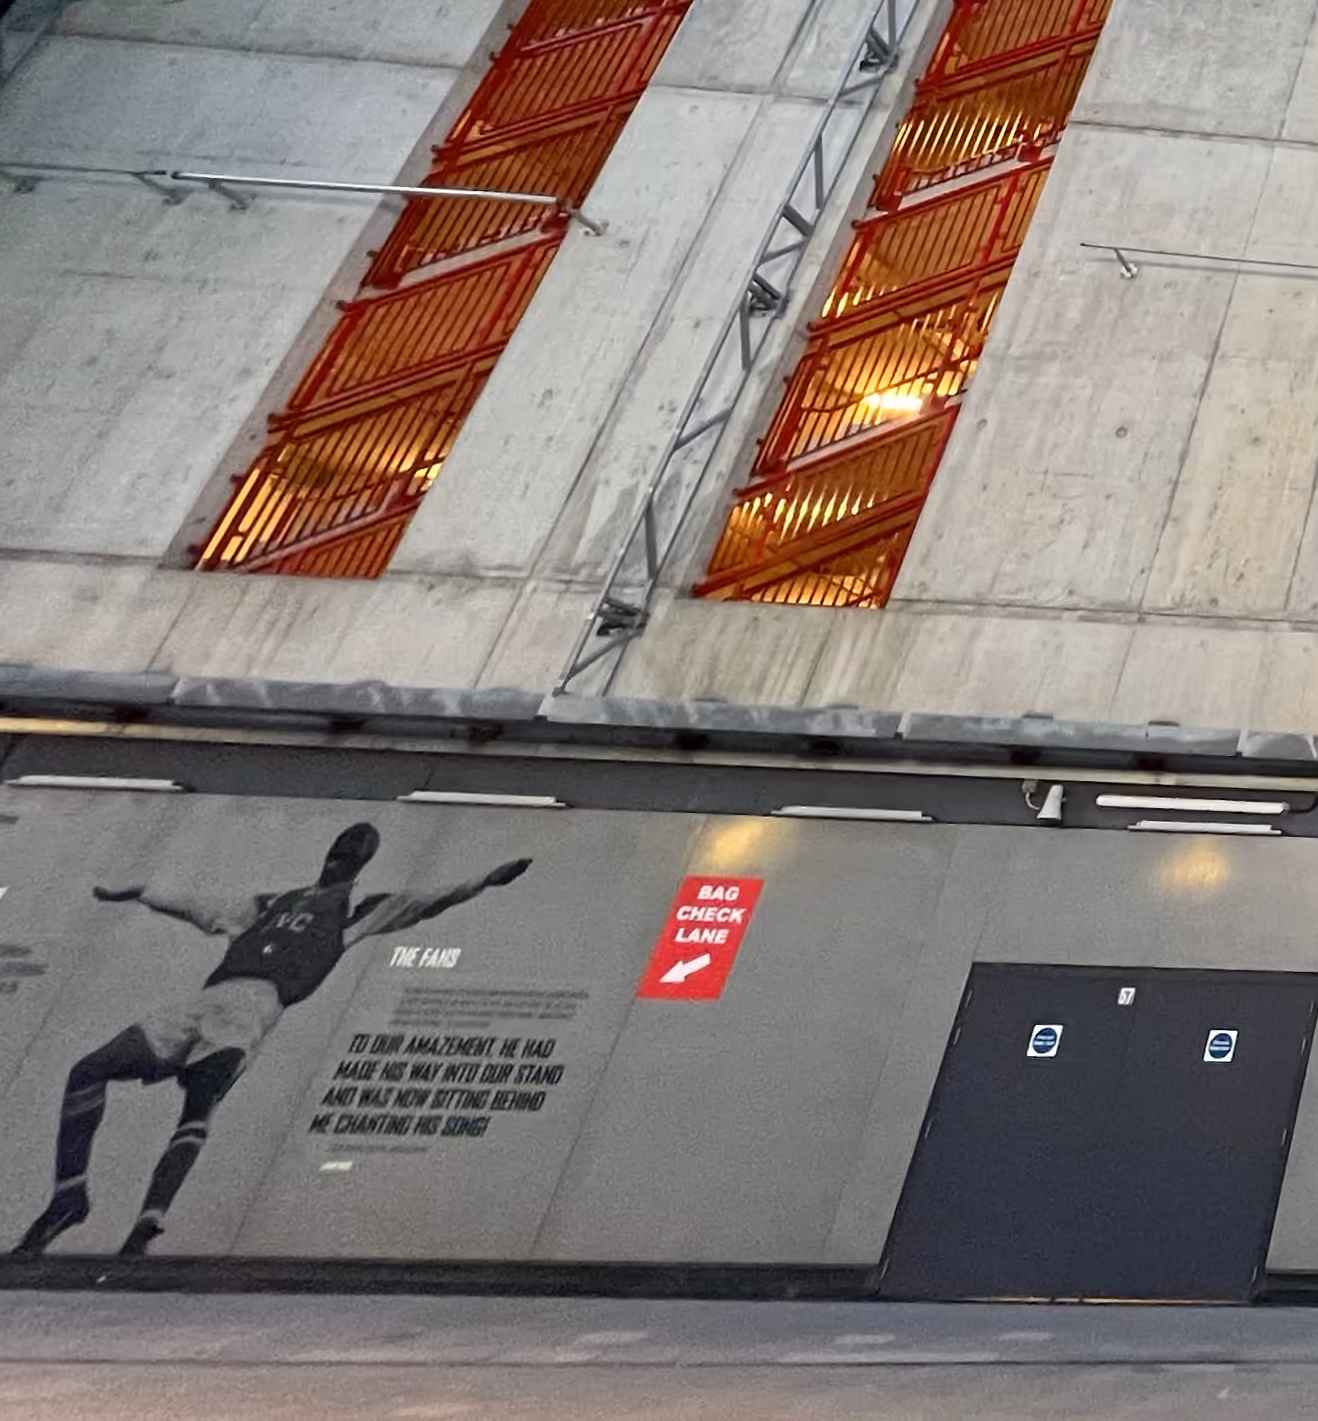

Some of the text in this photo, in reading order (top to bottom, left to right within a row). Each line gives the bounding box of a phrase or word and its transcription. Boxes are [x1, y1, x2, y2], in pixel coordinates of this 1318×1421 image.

[697, 885, 739, 901] BAG
[676, 906, 746, 924] CHECK
[674, 928, 729, 944] LANE
[390, 947, 420, 967] THE
[348, 1033, 372, 1055] TO
[370, 1034, 403, 1055] OUR
[499, 1038, 520, 1057] HE
[521, 1039, 556, 1059] HAD
[332, 1060, 565, 1085] MADE HIS WAY INTO OUR STAND
[321, 1087, 546, 1111] AND WAS NOW SITTING BEHIND
[308, 1113, 332, 1135] ME
[333, 1114, 414, 1137] CHANTING
[412, 1115, 442, 1137] HIS
